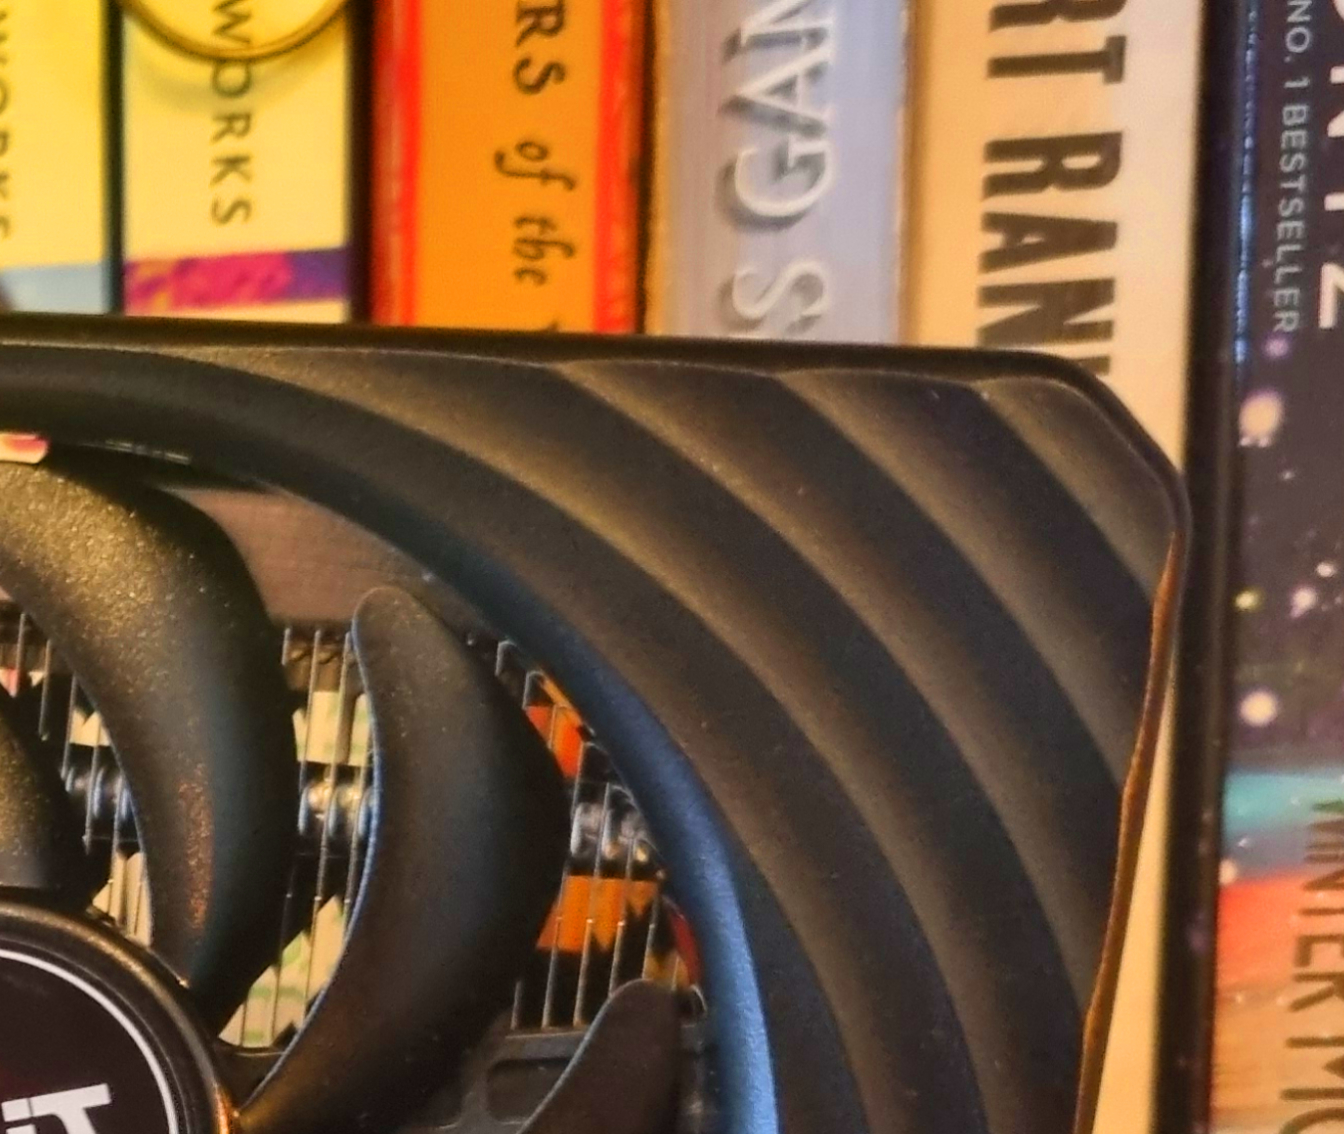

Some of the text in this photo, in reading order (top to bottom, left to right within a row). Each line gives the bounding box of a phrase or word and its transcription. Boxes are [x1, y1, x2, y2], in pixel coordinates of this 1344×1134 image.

[1283, 76, 1310, 91] 1
[492, 138, 578, 194] of
[511, 215, 577, 288] the
[976, 130, 1124, 378] RAN
[1272, 105, 1311, 334] BESTSELLER
